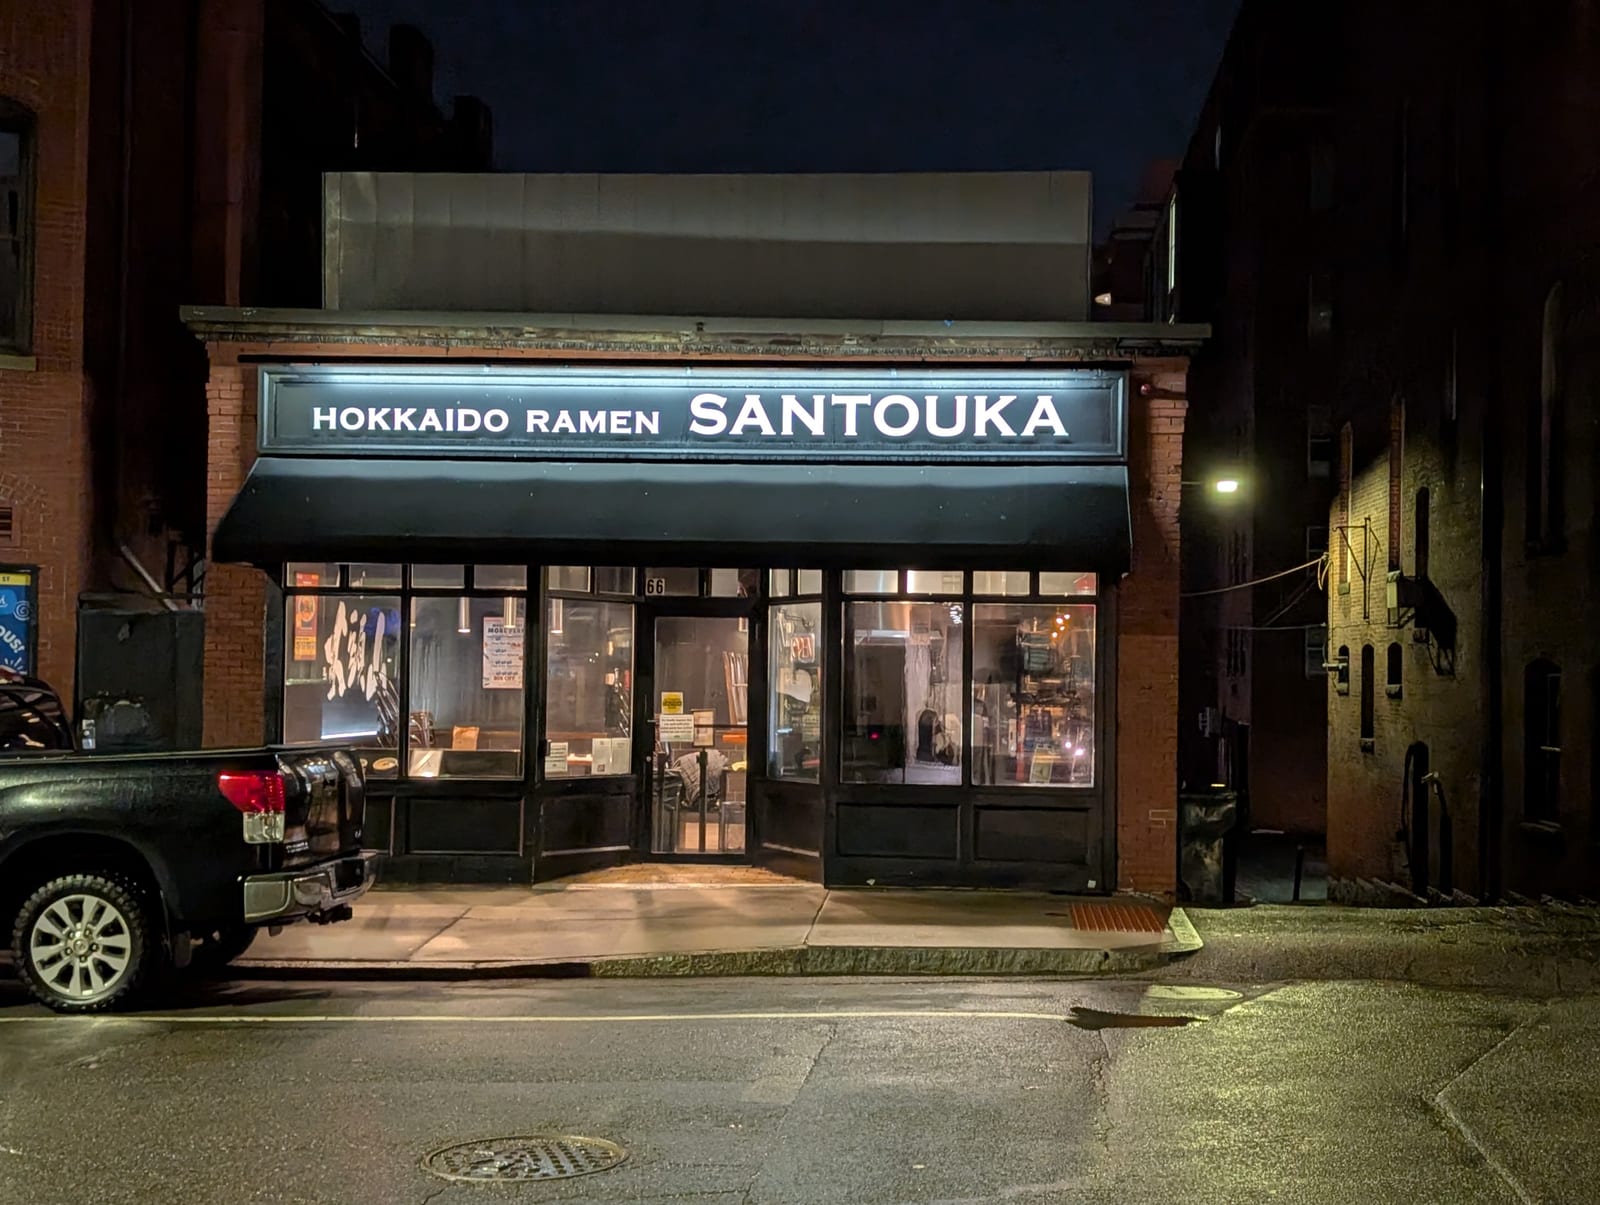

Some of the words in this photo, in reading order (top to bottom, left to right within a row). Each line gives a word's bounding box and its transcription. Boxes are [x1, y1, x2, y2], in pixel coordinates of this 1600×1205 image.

[312, 407, 509, 433] HOKKAIDO
[526, 409, 660, 435] RAMEN
[689, 393, 1069, 437] SANTOUKA
[647, 578, 663, 594] 66
